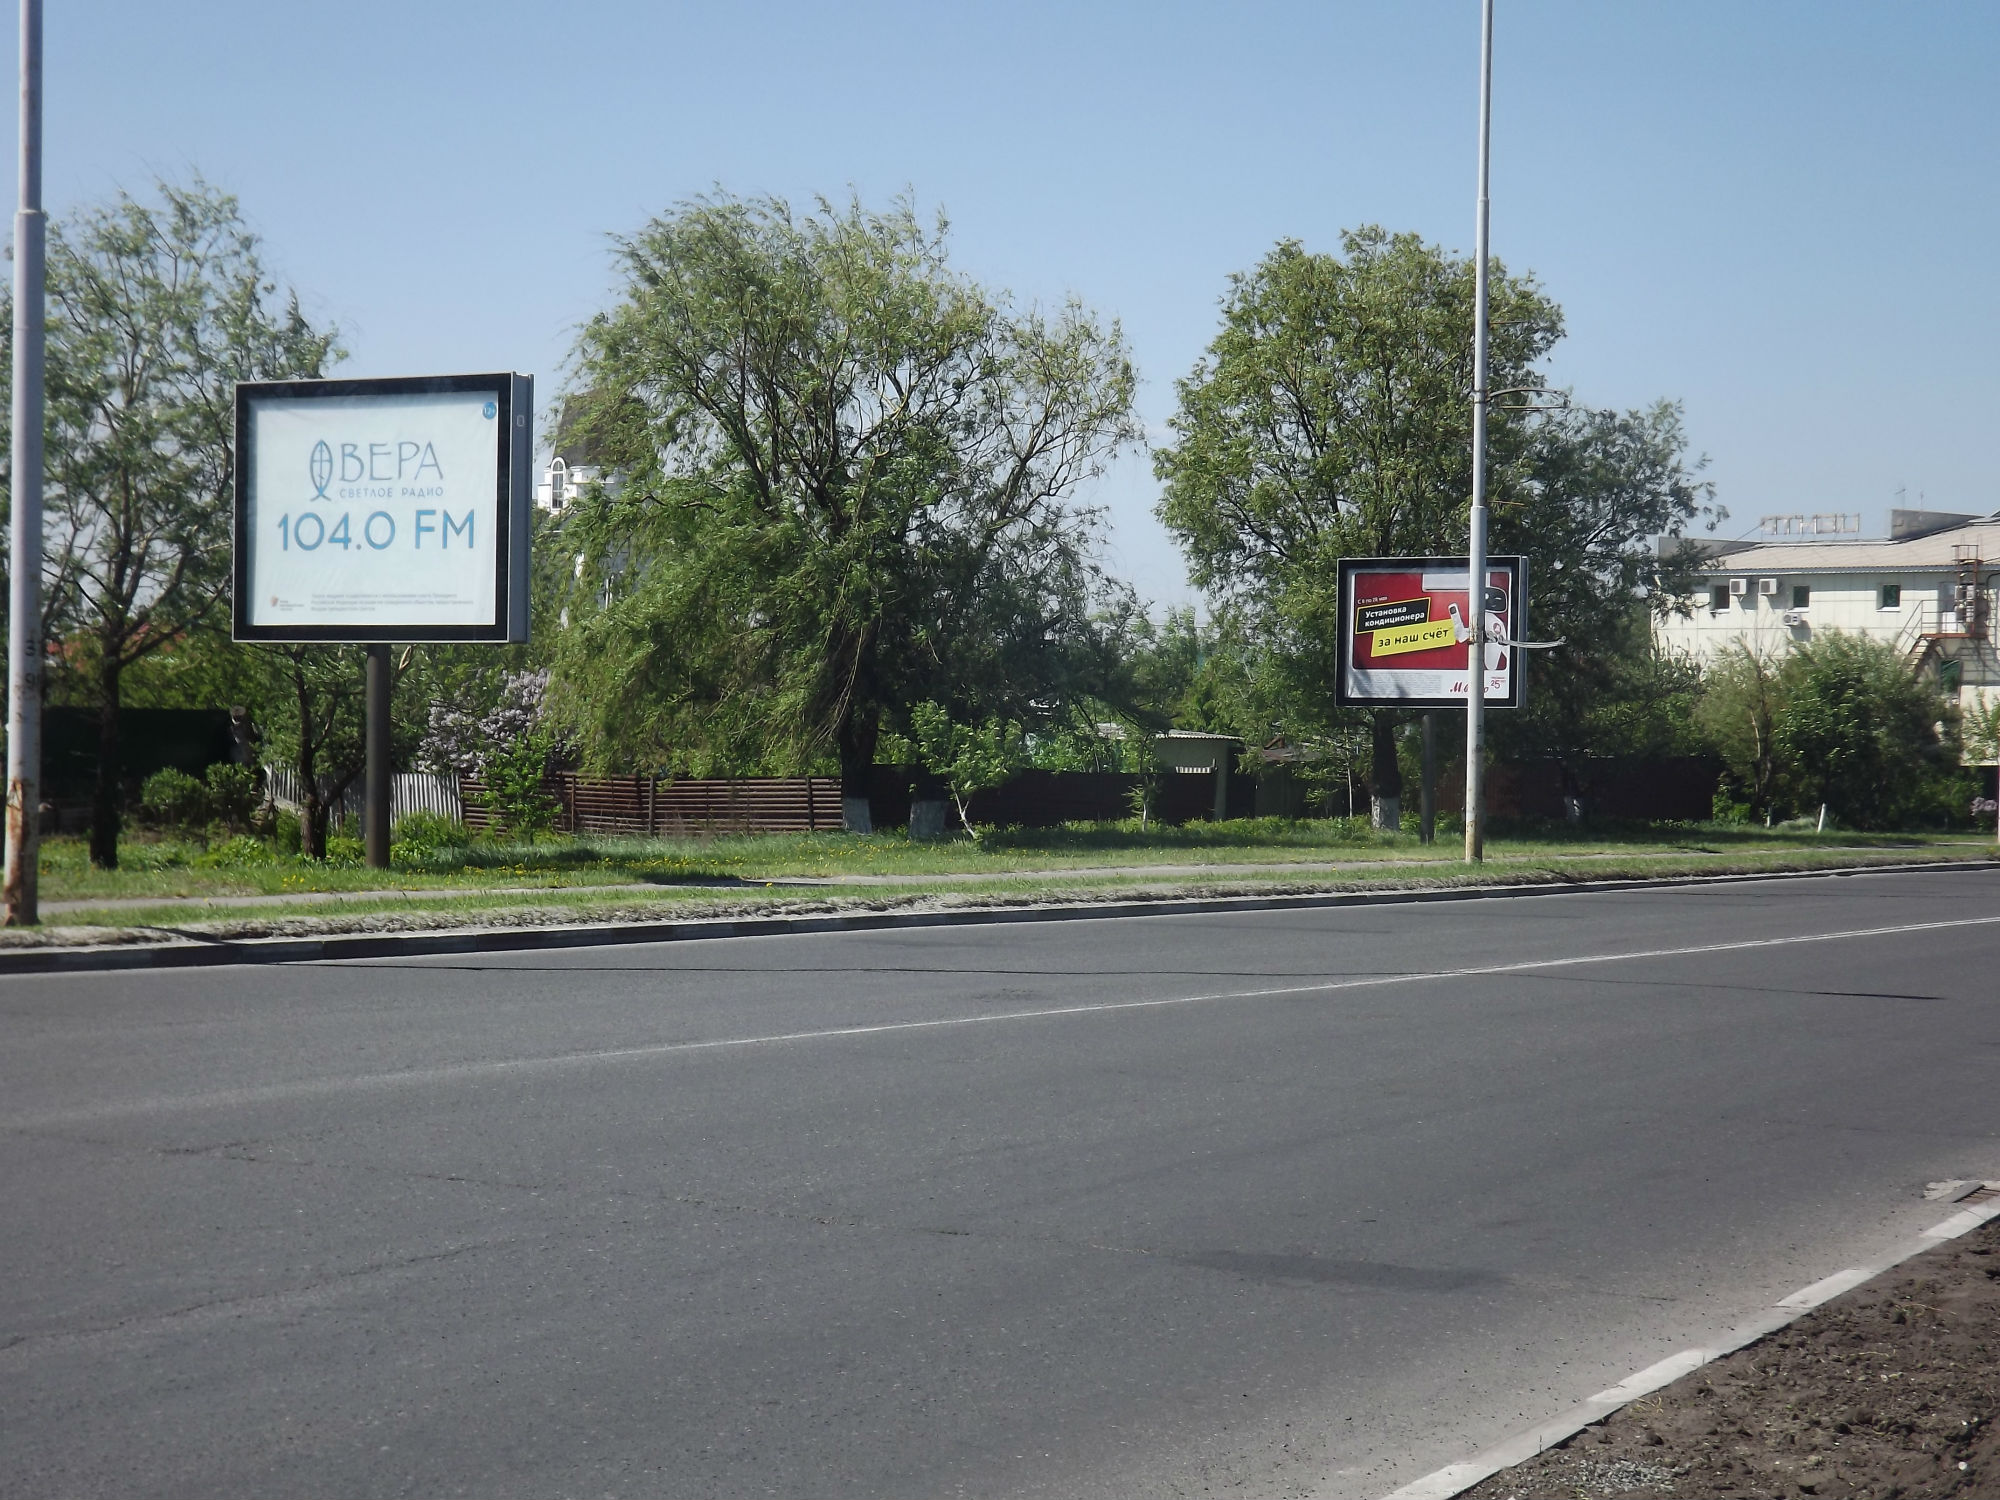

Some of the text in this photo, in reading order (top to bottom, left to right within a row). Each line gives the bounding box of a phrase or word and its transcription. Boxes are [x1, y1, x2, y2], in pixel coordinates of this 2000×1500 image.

[339, 441, 444, 482] ВЕРА
[339, 486, 444, 499] СВЕТЛОЕ РАДИО
[278, 509, 475, 551] 104.0 FM
[1365, 606, 1407, 618] Установка
[1365, 611, 1425, 627] кондиционера
[1378, 627, 1449, 647] за наш счёт
[1491, 680, 1501, 689] 25
